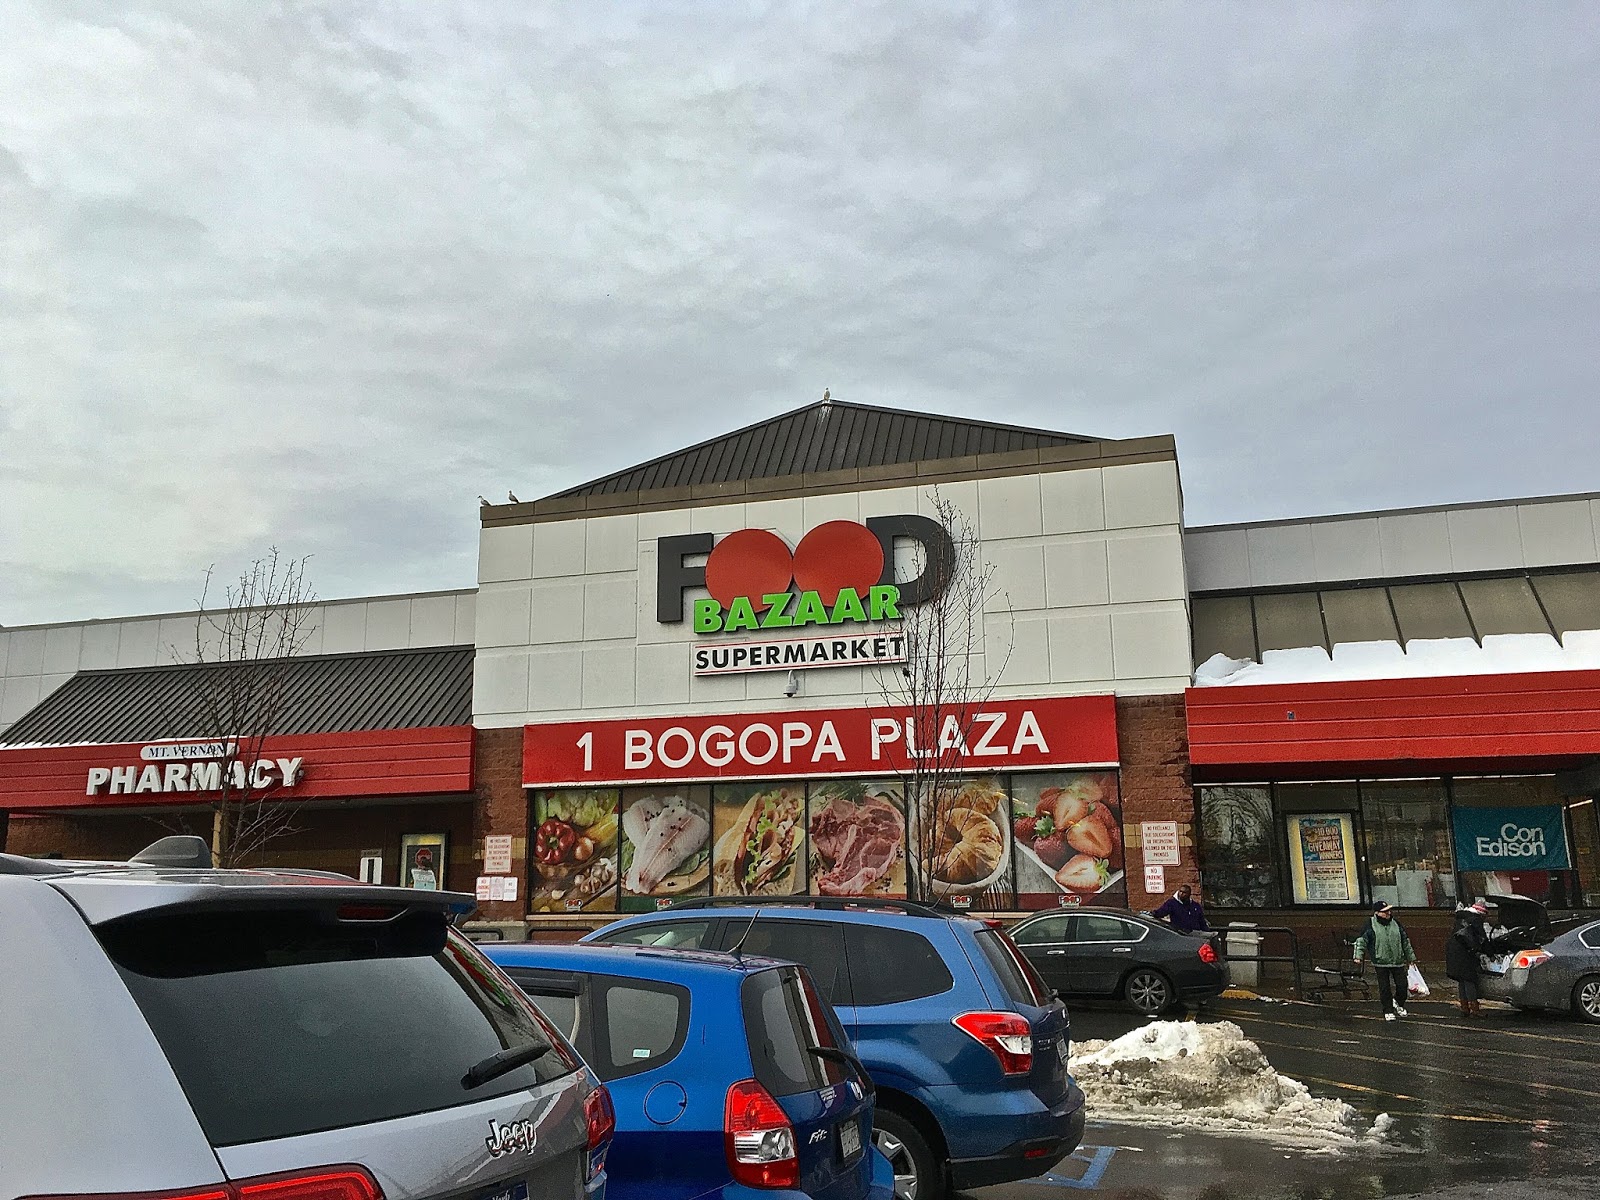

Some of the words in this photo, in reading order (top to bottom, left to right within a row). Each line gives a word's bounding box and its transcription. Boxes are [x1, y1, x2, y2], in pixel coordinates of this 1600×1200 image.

[657, 514, 955, 623] FOOD
[693, 584, 903, 634] BAZAAR
[695, 637, 904, 669] SUPERMARKET
[148, 747, 170, 758] MT.
[173, 742, 227, 757] VERNON
[576, 731, 593, 771] 1
[624, 720, 846, 770] BOGOPA
[870, 710, 1050, 761] PLAZA
[86, 757, 304, 796] PHARMACY
[1308, 840, 1341, 852] GIVEAWAY
[1476, 837, 1546, 856] Edison
[1501, 823, 1544, 842] Con
[485, 1119, 536, 1158] Jeep
